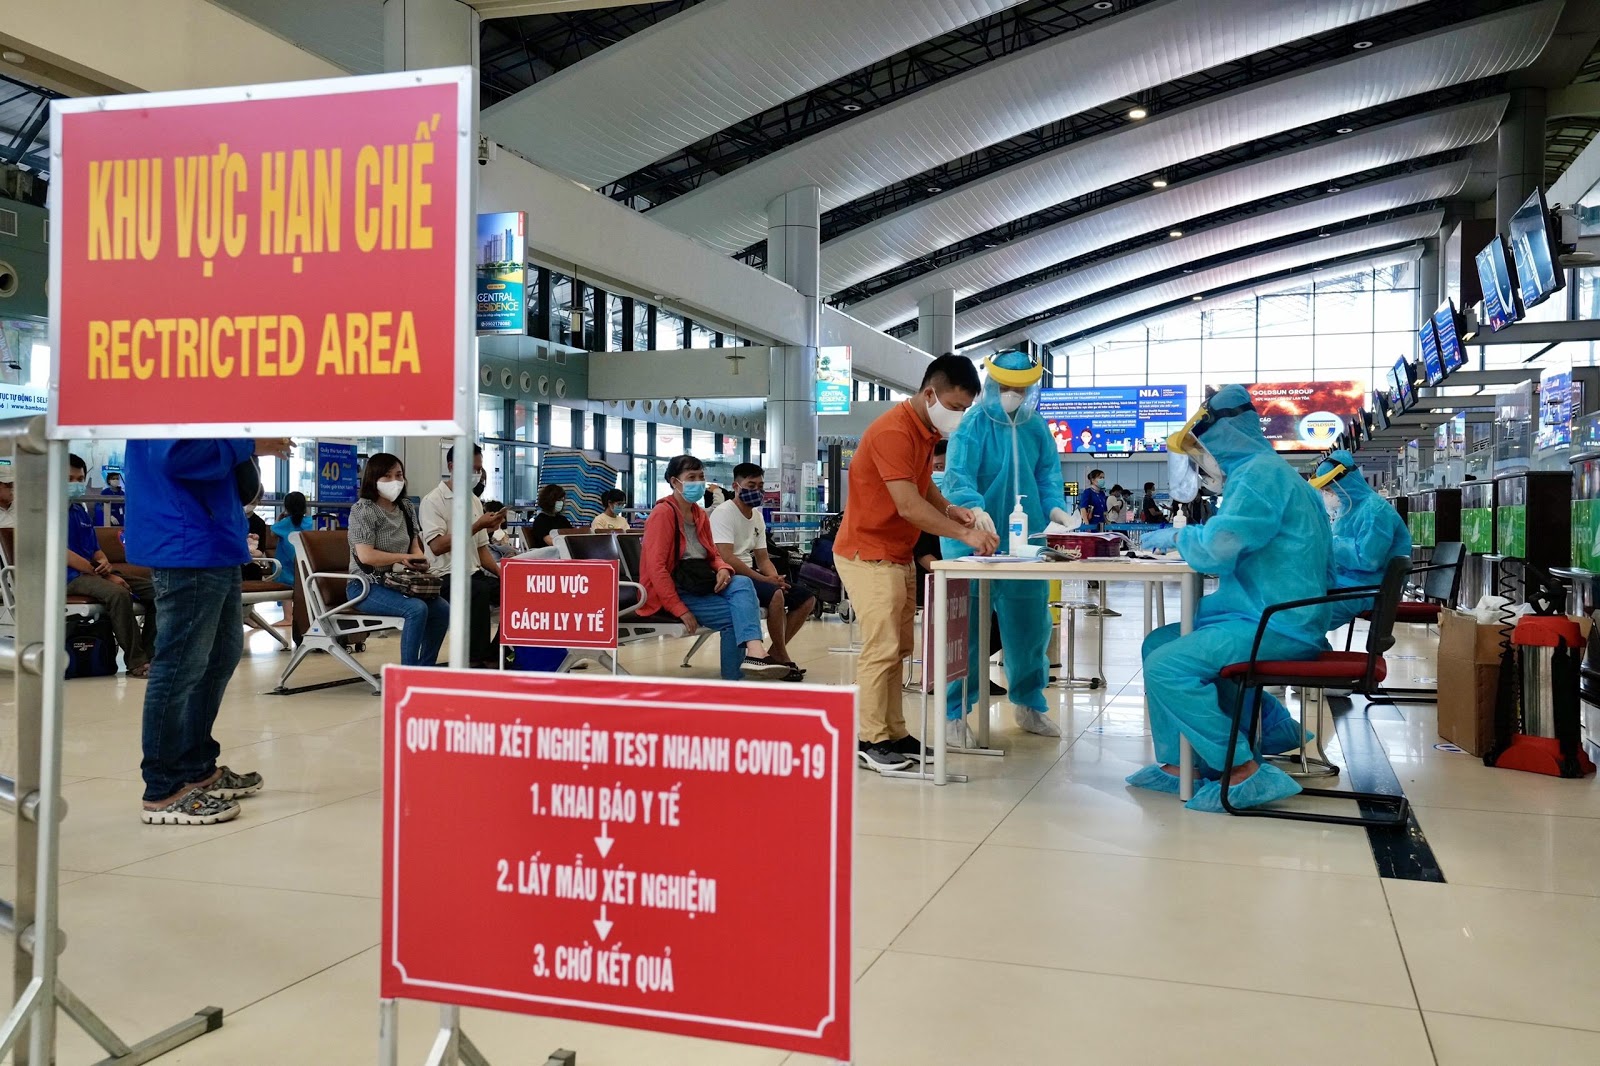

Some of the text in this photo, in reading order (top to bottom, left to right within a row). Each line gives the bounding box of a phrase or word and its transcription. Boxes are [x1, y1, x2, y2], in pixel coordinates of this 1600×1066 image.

[87, 113, 441, 278] KHU VỰC HẠN CHẾ
[476, 302, 519, 312] ESIDENCE
[477, 292, 515, 302] CENTRAL
[88, 315, 305, 380] RECTRICTED
[316, 311, 421, 376] AREA
[10, 394, 17, 402] TỰ
[18, 393, 32, 403] ĐỘNG
[322, 462, 339, 481] 40
[526, 574, 589, 598] KHU VỰC
[511, 608, 605, 632] CÁCH LY Y TẾ
[406, 715, 825, 779] QUY TRÌNH XÉT NGHIỆM TEST NHANH COVID-19
[531, 782, 682, 827] 1. KHAI BÁO Y TẾ
[497, 851, 716, 918] 2. LẤY MẪU XÉT NGHIỆM
[534, 942, 674, 993] 3. CHỜ KẾT QUẢ
